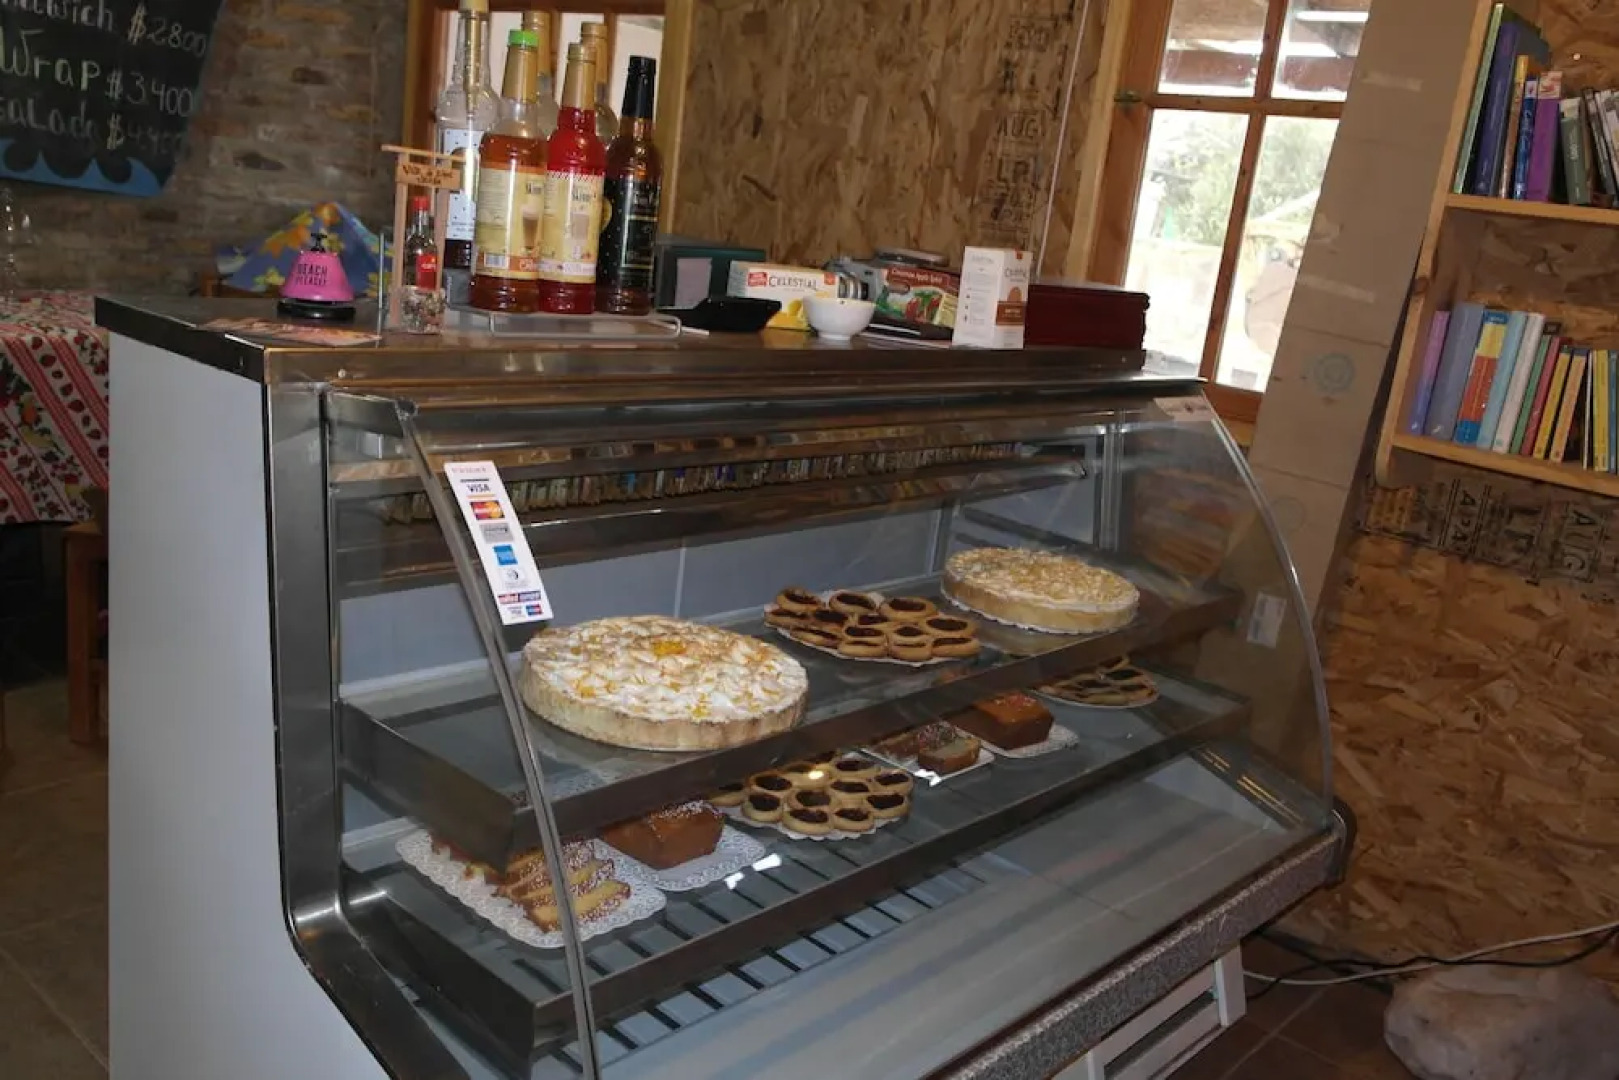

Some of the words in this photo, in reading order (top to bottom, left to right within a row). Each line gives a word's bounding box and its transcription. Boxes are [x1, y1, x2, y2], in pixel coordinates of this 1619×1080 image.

[0, 26, 101, 91] Wrap
[769, 275, 818, 290] CELESTIAL
[466, 483, 491, 493] VISA
